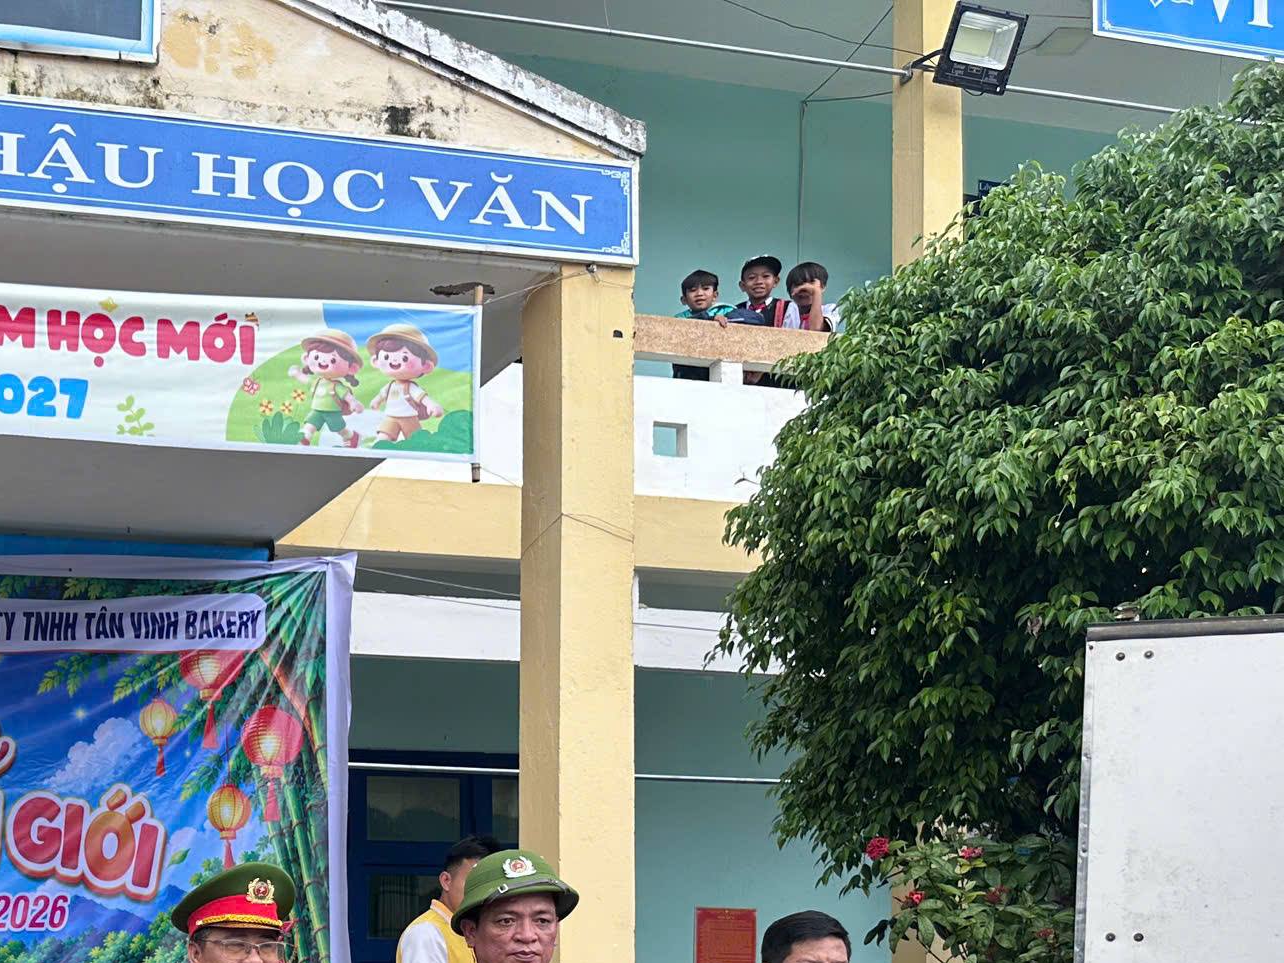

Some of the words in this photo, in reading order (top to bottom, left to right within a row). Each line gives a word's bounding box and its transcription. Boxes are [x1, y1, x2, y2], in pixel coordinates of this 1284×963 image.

[192, 153, 386, 218] HỌC
[409, 171, 594, 236] VĂN
[46, 309, 148, 367] HỌC
[156, 312, 257, 365] MỚI
[22, 611, 79, 642] TNHH
[84, 606, 126, 641] TÂN
[130, 610, 179, 641] VINH
[184, 609, 262, 641] BAKERY
[13, 788, 159, 889] GIỚI
